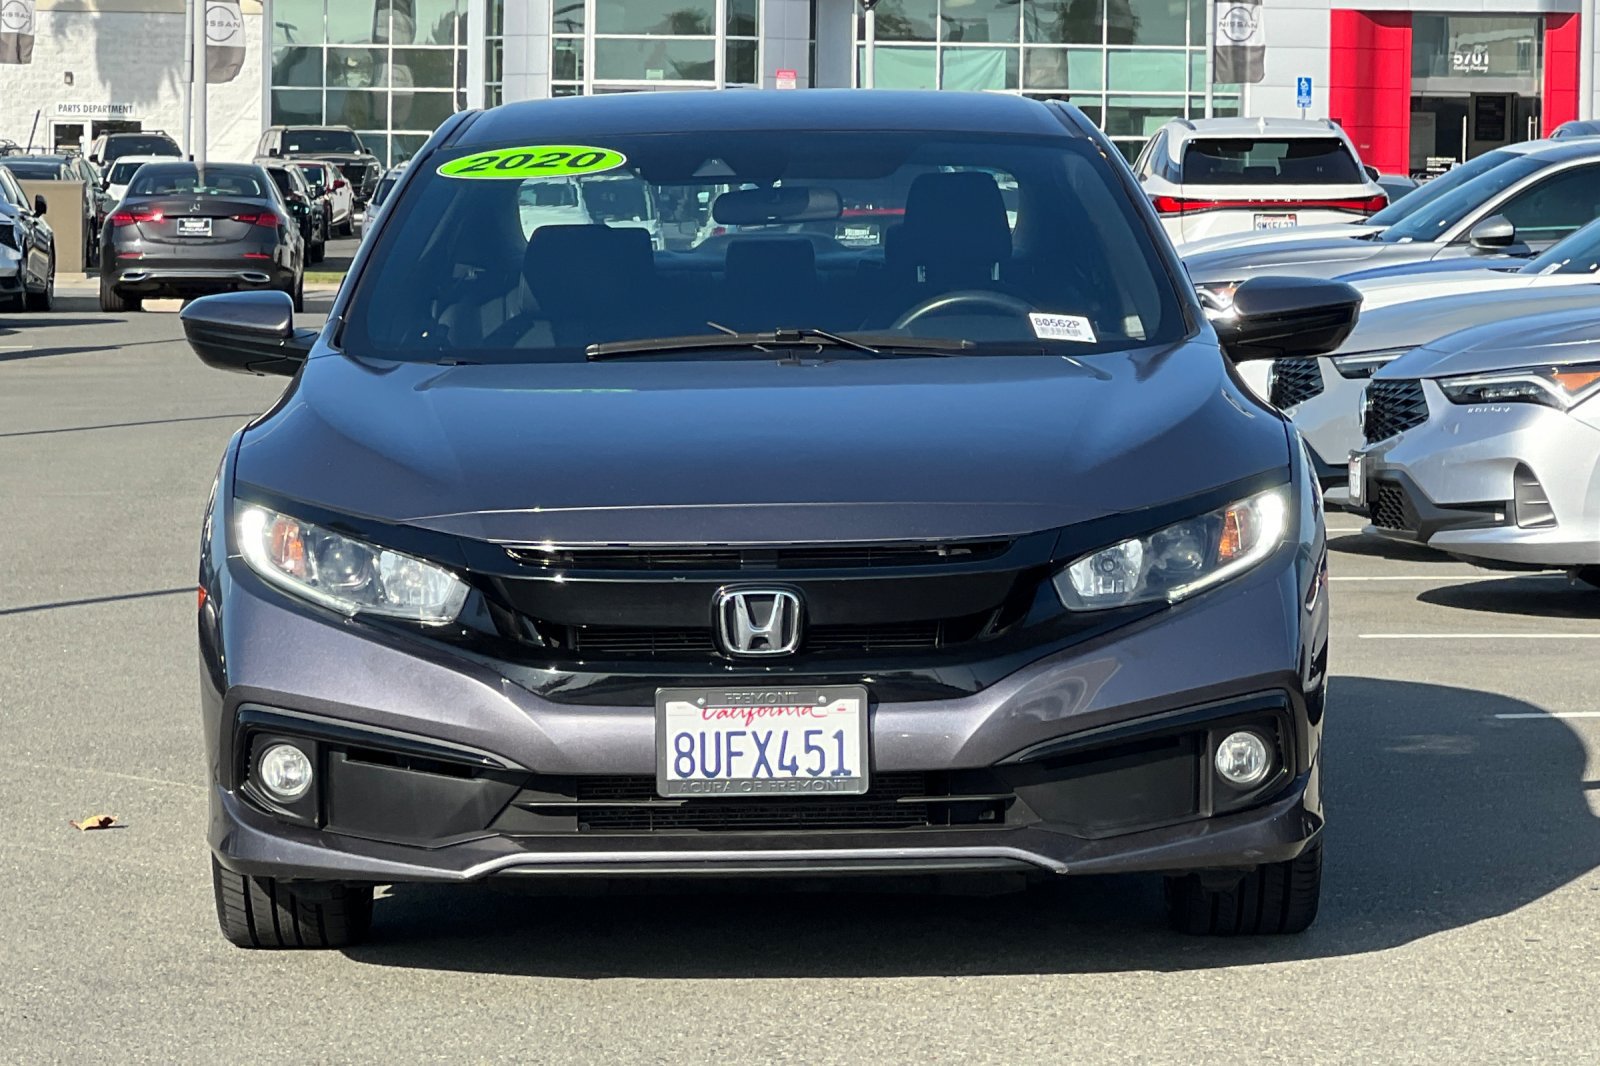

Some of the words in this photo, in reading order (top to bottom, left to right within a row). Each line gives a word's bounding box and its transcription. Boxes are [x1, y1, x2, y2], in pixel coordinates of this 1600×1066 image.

[1219, 21, 1258, 29] NISSAN
[1453, 51, 1489, 65] 5701
[58, 104, 81, 113] PARTS
[83, 104, 133, 114] DEPARTMENT
[453, 152, 608, 174] 2020
[1034, 317, 1080, 328] 80562P
[724, 691, 800, 704] FREMONT
[702, 705, 828, 727] California
[673, 729, 853, 779] 8UFX451
[679, 780, 731, 793] ACURA
[739, 780, 763, 792] OF
[767, 779, 849, 792] FREMONT
